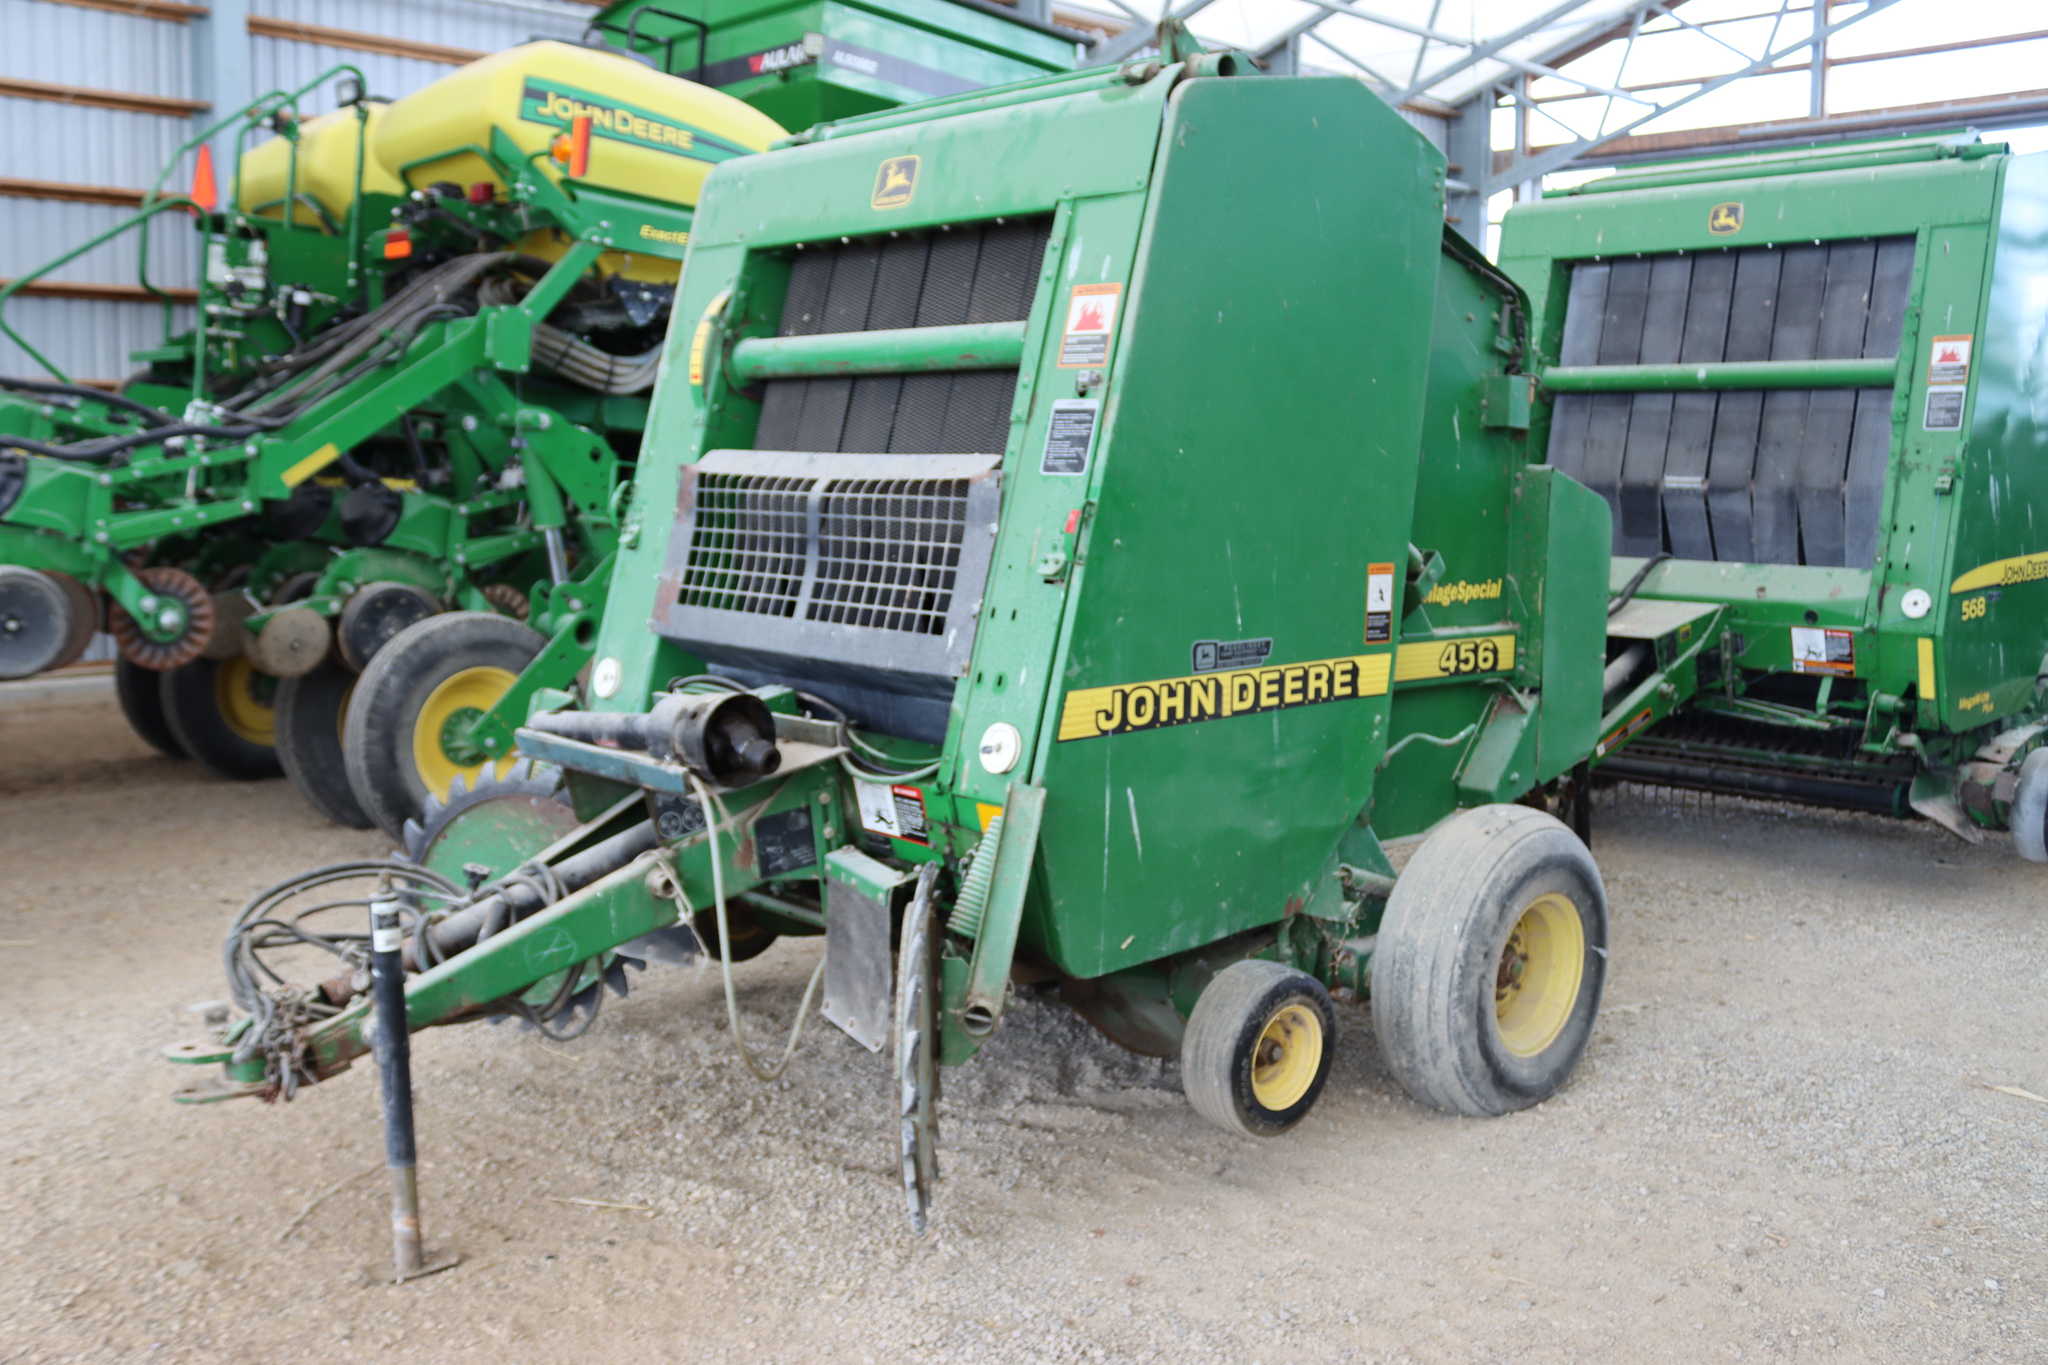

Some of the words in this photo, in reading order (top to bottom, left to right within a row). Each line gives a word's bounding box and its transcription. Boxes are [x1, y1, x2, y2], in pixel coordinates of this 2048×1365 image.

[536, 91, 613, 131] JOHN
[614, 108, 695, 151] DEERE
[640, 224, 691, 247] ExactE
[2000, 563, 2025, 583] JOHN
[2026, 559, 2048, 579] DEER
[1423, 578, 1502, 607] ilageSpecial
[1961, 595, 1986, 621] 568
[1439, 639, 1498, 675] 456
[1096, 677, 1221, 735] JOHN
[1231, 660, 1358, 715] DEERE
